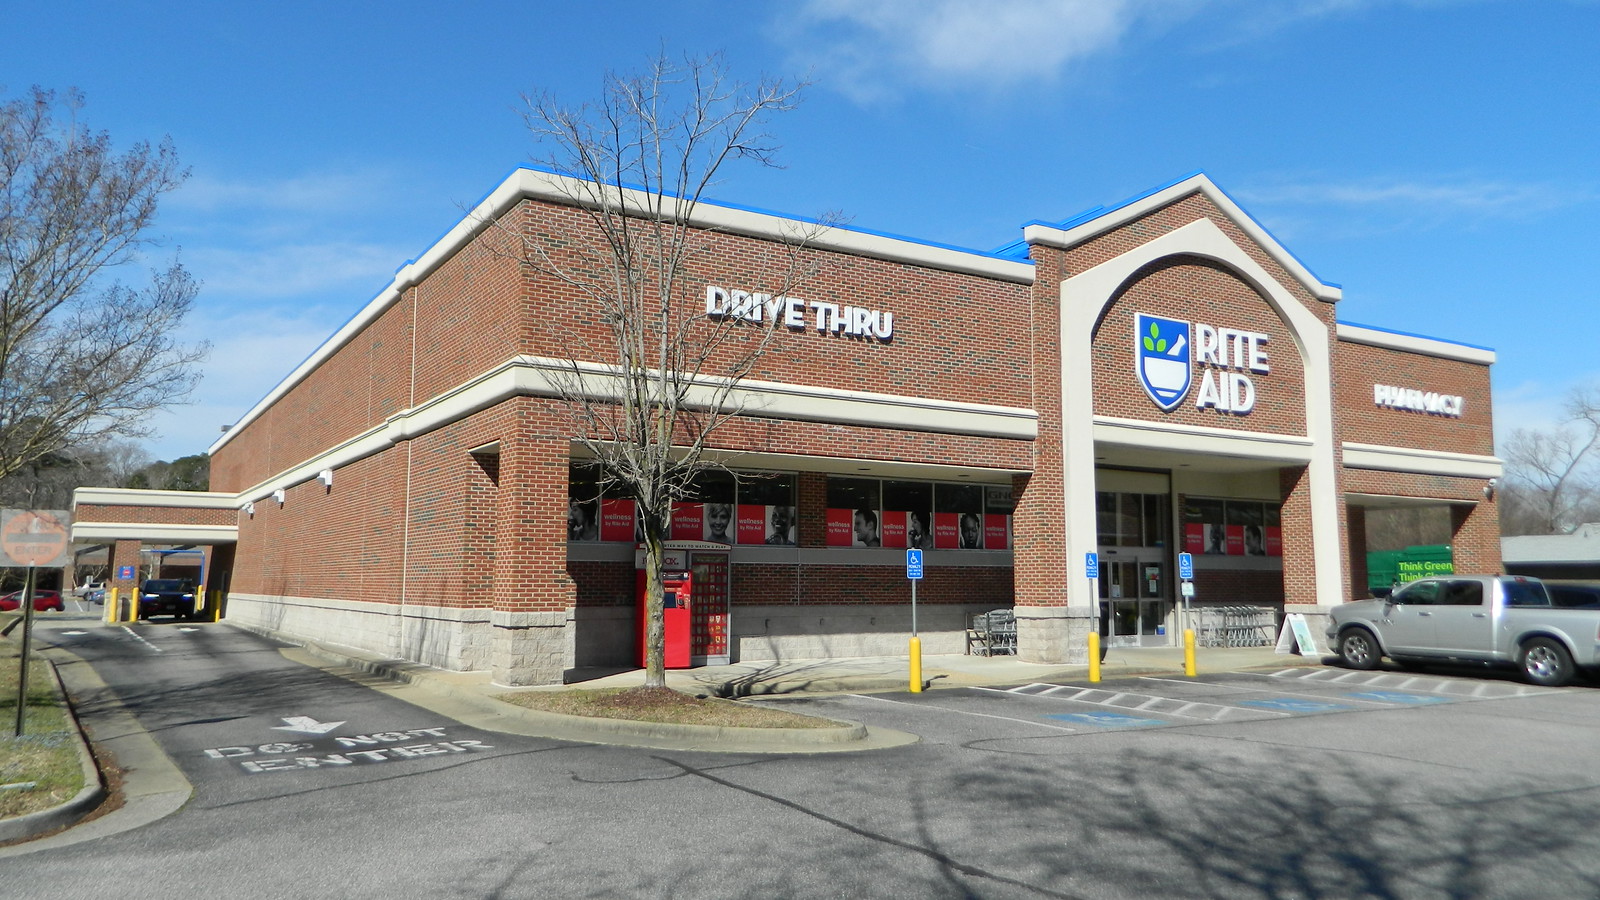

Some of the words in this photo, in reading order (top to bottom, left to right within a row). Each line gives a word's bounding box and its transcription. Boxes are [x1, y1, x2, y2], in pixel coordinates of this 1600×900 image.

[706, 285, 805, 329] DRIVE
[810, 301, 894, 340] THRU
[1195, 322, 1270, 374] RITE
[1195, 368, 1256, 415] AID
[1398, 561, 1424, 571] Think
[1424, 561, 1454, 572] Green
[204, 742, 314, 760] DO
[335, 727, 446, 748] NOT
[240, 739, 495, 774] ENTER
